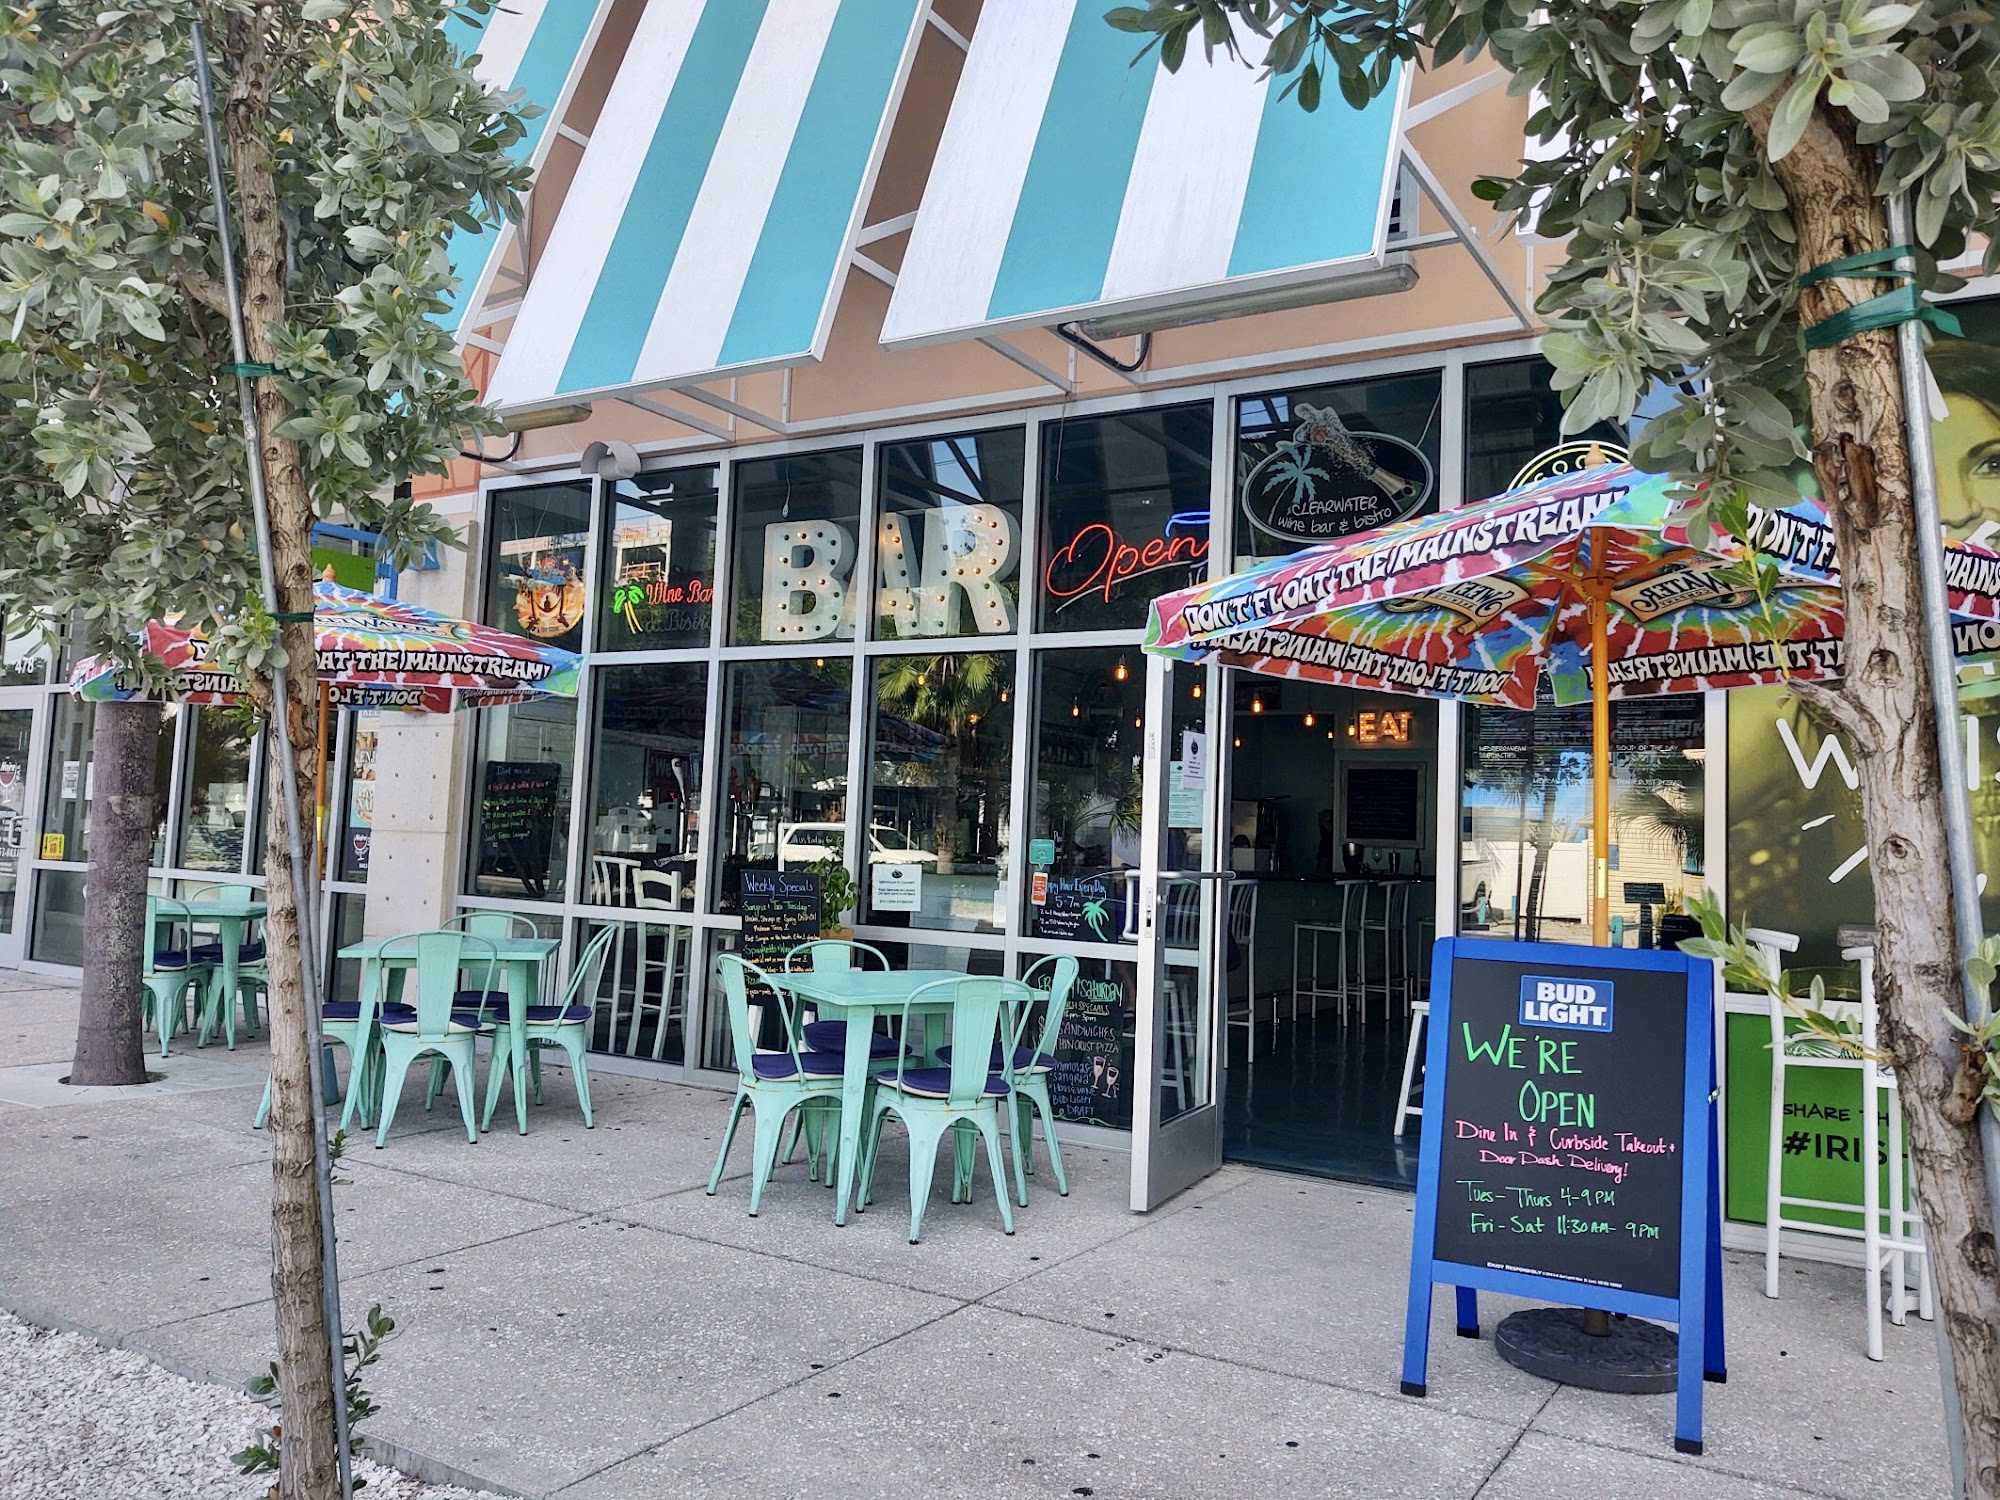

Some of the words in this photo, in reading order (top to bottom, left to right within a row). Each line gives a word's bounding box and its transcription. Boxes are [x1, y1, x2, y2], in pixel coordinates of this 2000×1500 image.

[1278, 516, 1305, 532] wine
[1311, 519, 1335, 534] bar
[1339, 518, 1350, 534] &
[1353, 507, 1391, 529] bistro
[1291, 496, 1378, 516] CLEARWATER
[761, 502, 1020, 641] BAR
[1046, 523, 1211, 603] Open
[1185, 597, 1251, 634] DON'T
[1252, 574, 1331, 618] FLOAT
[1337, 552, 1389, 591] THE
[15, 657, 35, 674] 478
[355, 651, 400, 671] THE
[403, 651, 551, 681] MAINSTREAM!
[1359, 710, 1413, 743] EAT
[744, 872, 776, 900] Weekly
[778, 874, 814, 898] Specials
[1536, 981, 1597, 1005] BUD
[1524, 1000, 1608, 1027] LIGHT
[1462, 1021, 1583, 1075] WE'RE
[1518, 1079, 1596, 1129] OPEN
[1783, 1103, 1851, 1122] SHARE
[1455, 1120, 1497, 1143] Dine
[1503, 1122, 1519, 1142] In
[1550, 1127, 1610, 1151] Curbside
[1613, 1131, 1667, 1154] Takeout
[1783, 1131, 1888, 1166] #IRIS
[1479, 1150, 1516, 1165] Door
[1518, 1151, 1564, 1167] Dash
[1567, 1152, 1629, 1184] Delivery!
